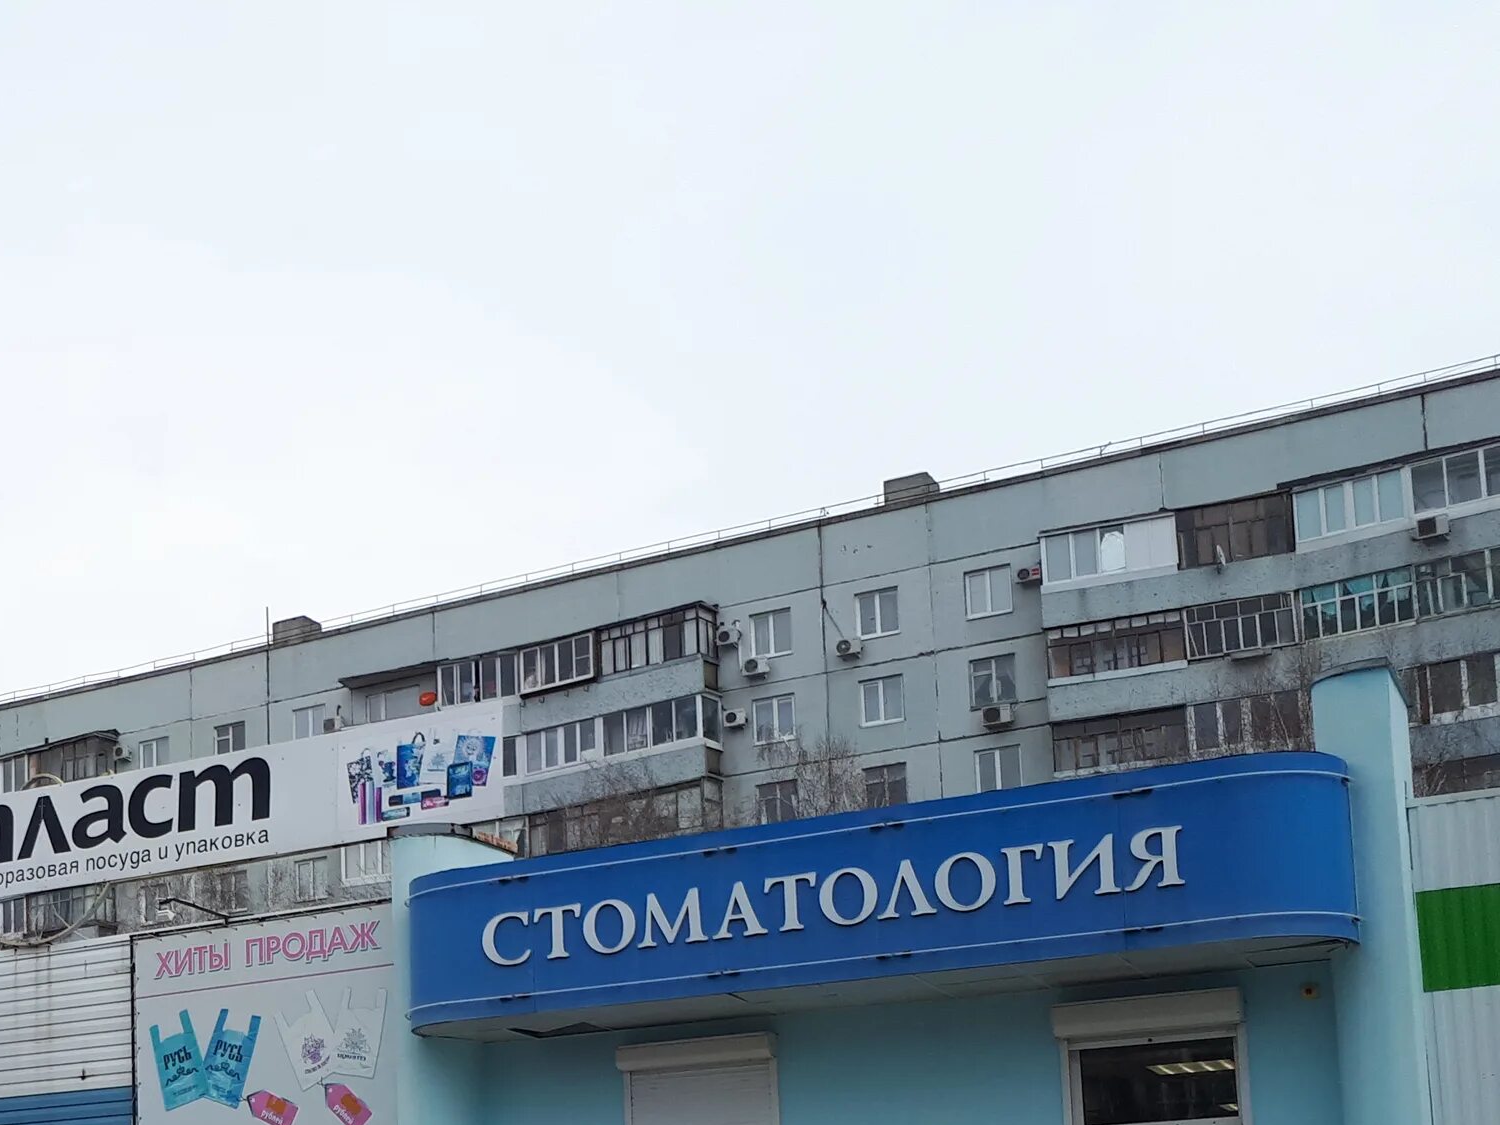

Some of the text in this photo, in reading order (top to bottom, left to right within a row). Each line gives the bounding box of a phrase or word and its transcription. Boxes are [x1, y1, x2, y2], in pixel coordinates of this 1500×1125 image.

[85, 848, 152, 874] посуда
[157, 845, 169, 860] и
[173, 828, 270, 863] упаковка
[480, 825, 1186, 967] СТОМАТОЛОГИЯ
[154, 920, 382, 980] ХИТЫ ПРОДАЖ
[261, 1109, 284, 1125] рублей
